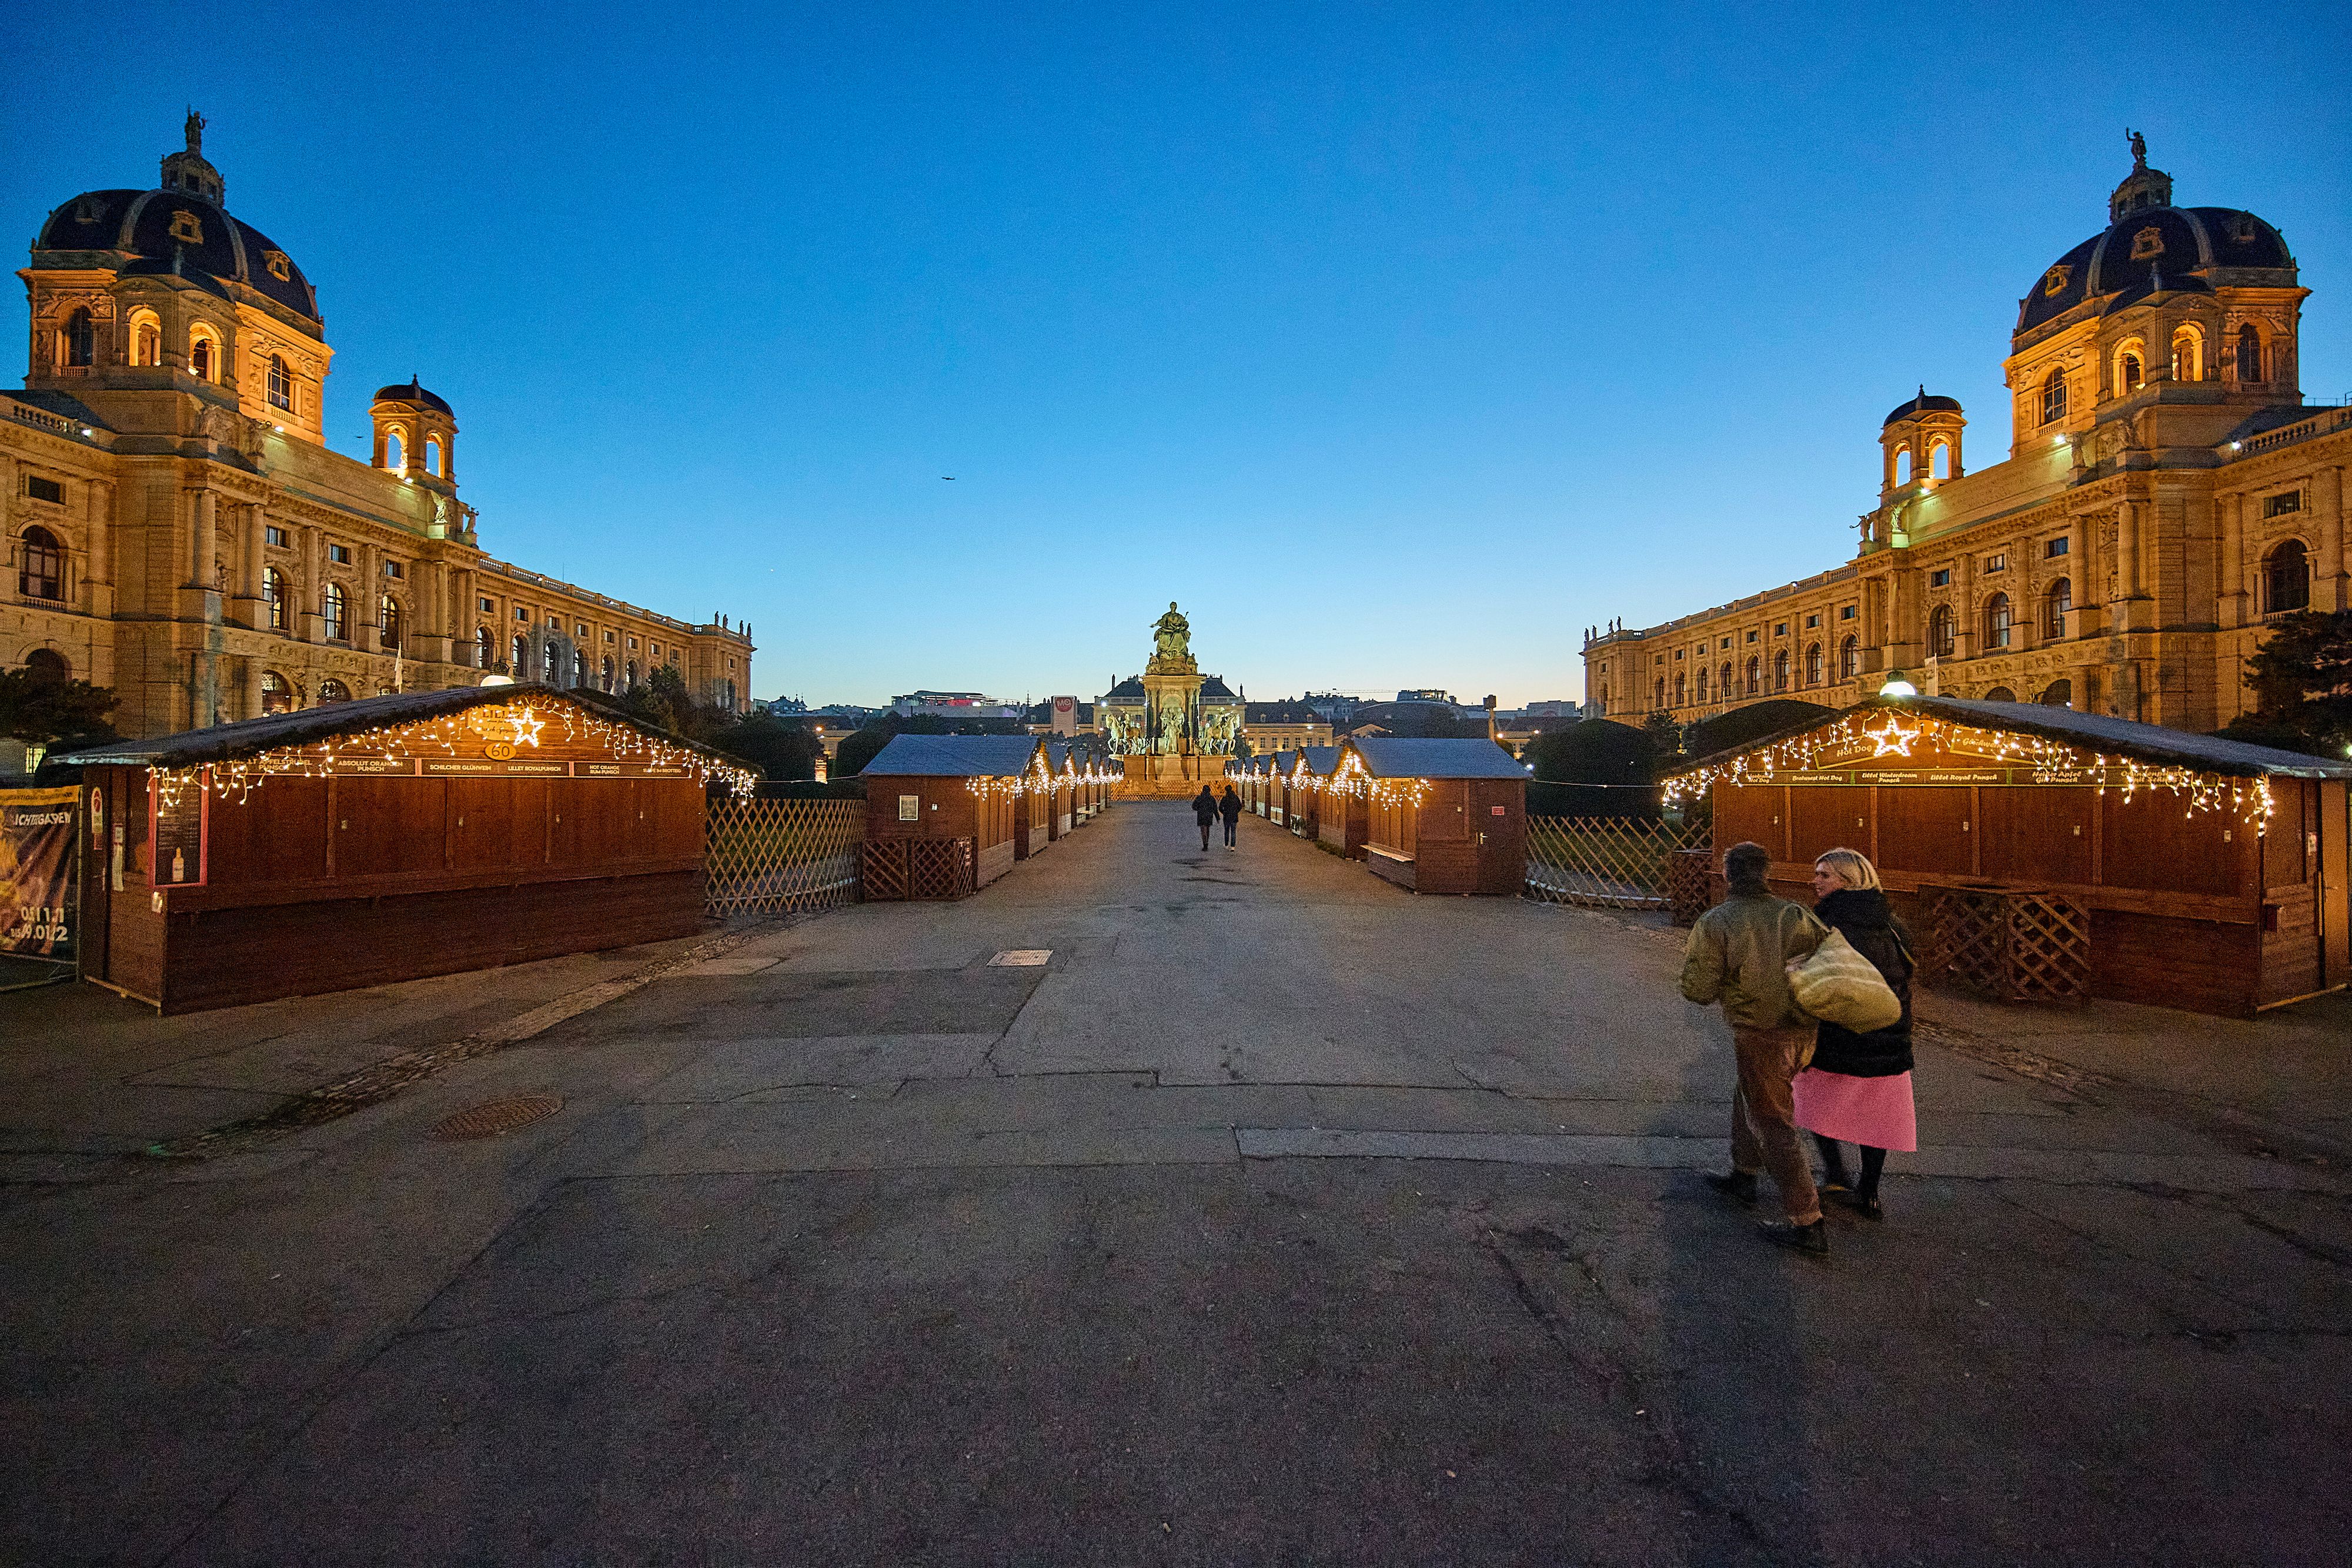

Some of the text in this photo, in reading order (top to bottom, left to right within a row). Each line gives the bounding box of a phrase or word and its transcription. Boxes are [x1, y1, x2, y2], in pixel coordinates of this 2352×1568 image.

[492, 745, 510, 757] 60
[1837, 745, 1872, 757] Hot Dog
